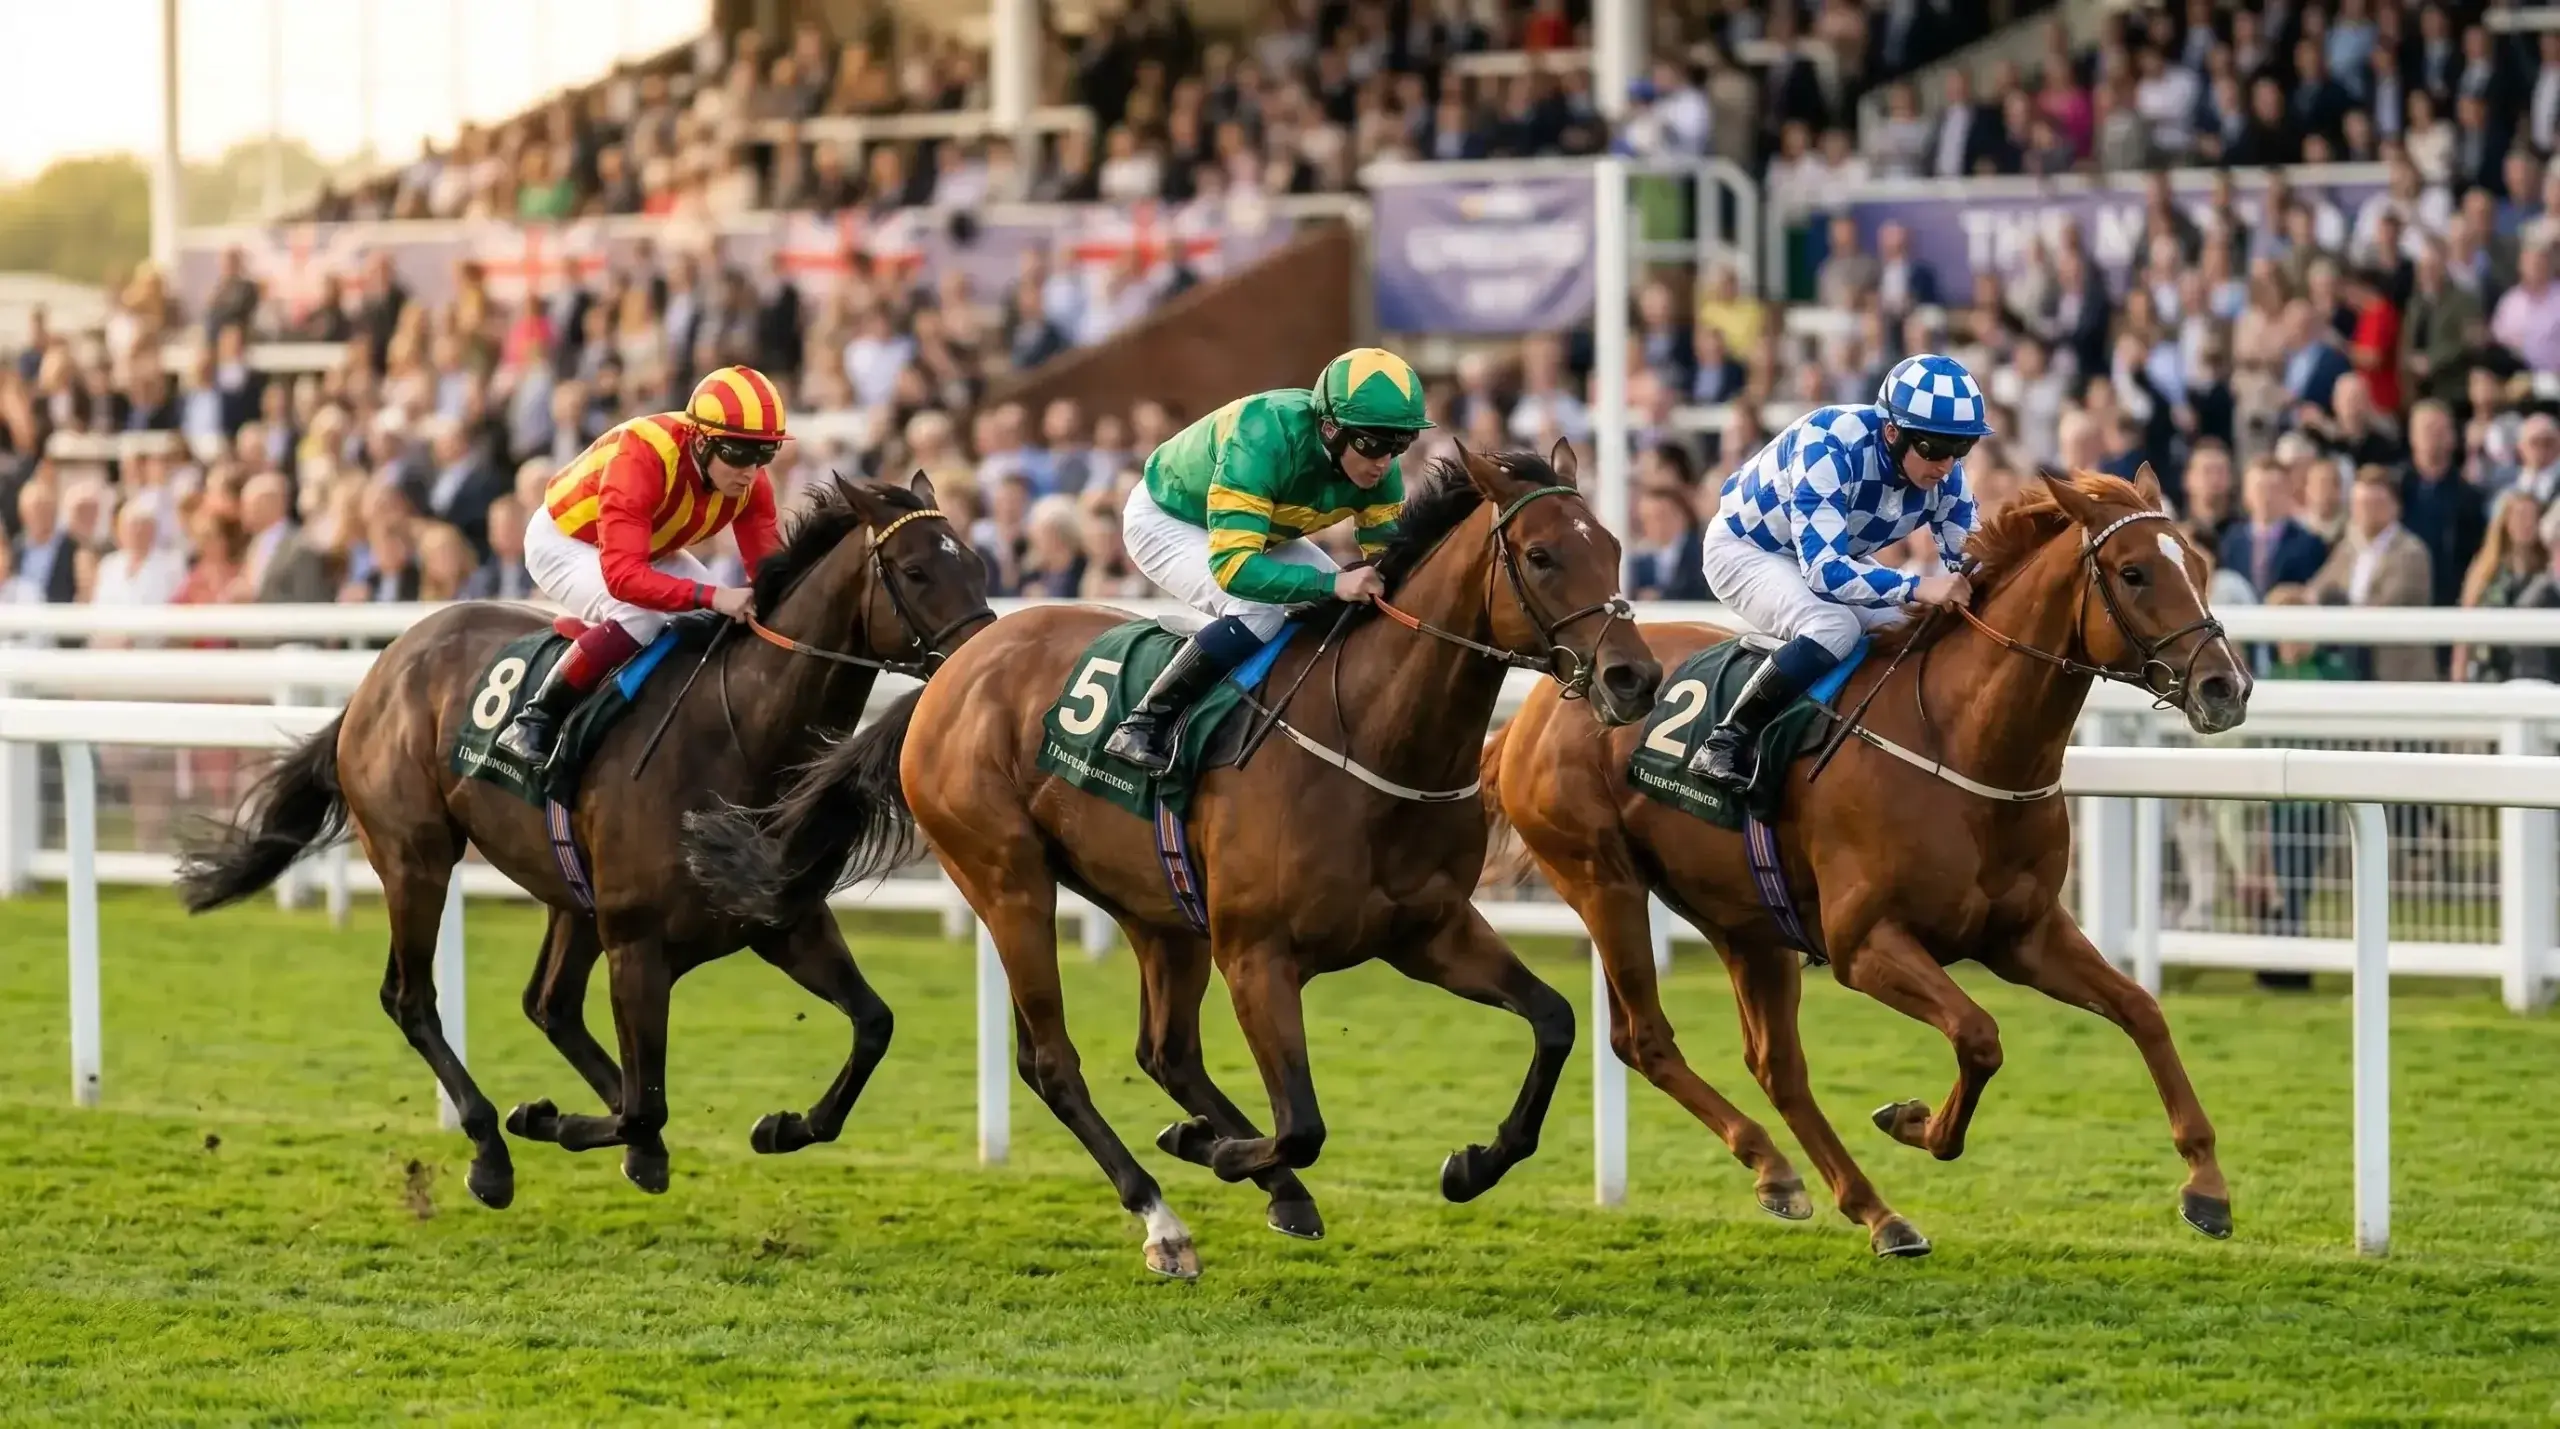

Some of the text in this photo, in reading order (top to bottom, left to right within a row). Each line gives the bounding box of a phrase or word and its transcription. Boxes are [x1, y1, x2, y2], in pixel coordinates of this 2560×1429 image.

[472, 657, 527, 730] 8
[1058, 656, 1123, 735] 5
[1645, 678, 1708, 759] 2
